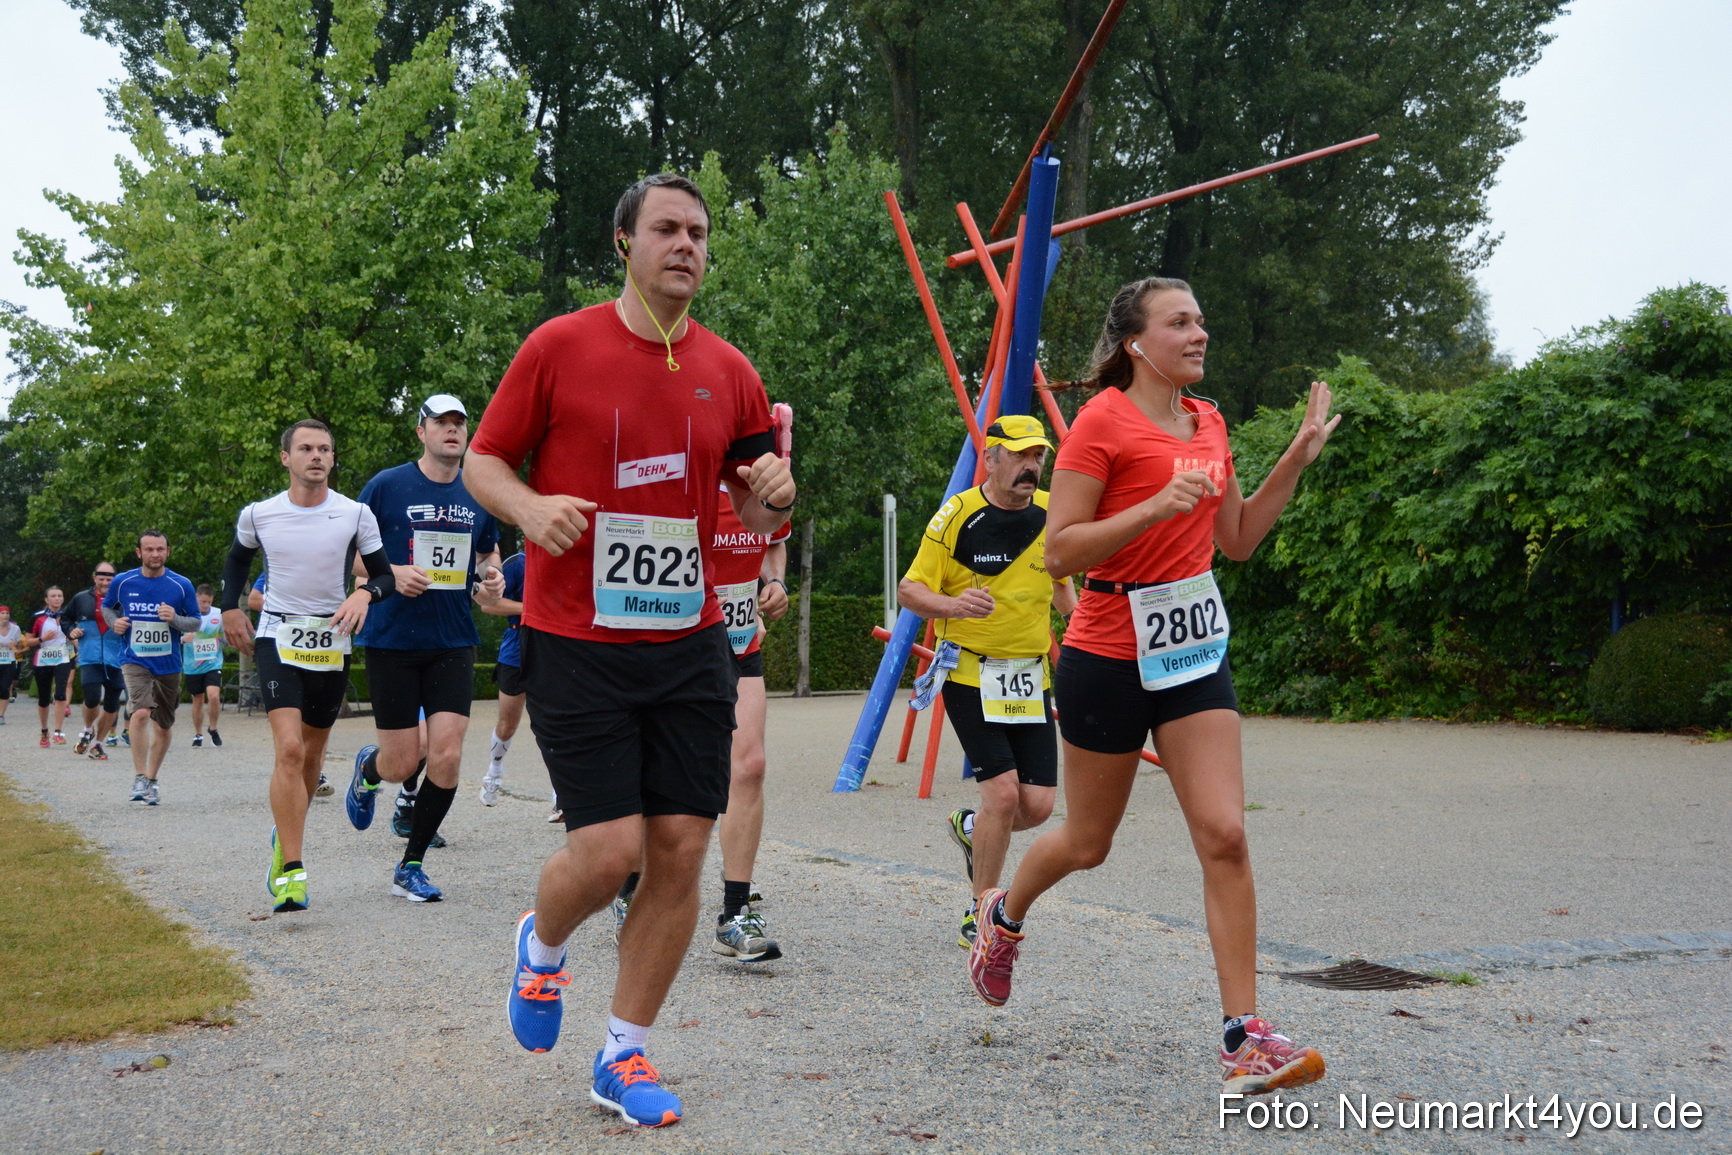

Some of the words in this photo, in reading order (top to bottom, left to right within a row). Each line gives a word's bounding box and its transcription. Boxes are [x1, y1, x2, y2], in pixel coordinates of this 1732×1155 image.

[638, 463, 667, 478] DEHN
[448, 504, 477, 520] HiRo
[448, 516, 463, 524] Run
[605, 526, 645, 535] NeuerMarkt
[432, 546, 455, 568] 54
[606, 542, 699, 587] 2623
[973, 554, 1002, 563] Heinz
[1003, 553, 1012, 562] L.
[433, 572, 451, 582] Sven
[1178, 576, 1213, 597] BOCK
[624, 596, 681, 614] Markus
[1140, 595, 1173, 607] NeuerMarkt
[1146, 597, 1224, 650] 2802
[135, 629, 169, 643] 2906
[291, 628, 333, 649] 238
[196, 643, 215, 653] 2452
[294, 652, 330, 663] Andreas
[1161, 648, 1220, 673] Veronika
[996, 672, 1034, 697] 145
[1004, 703, 1027, 714] Heinz
